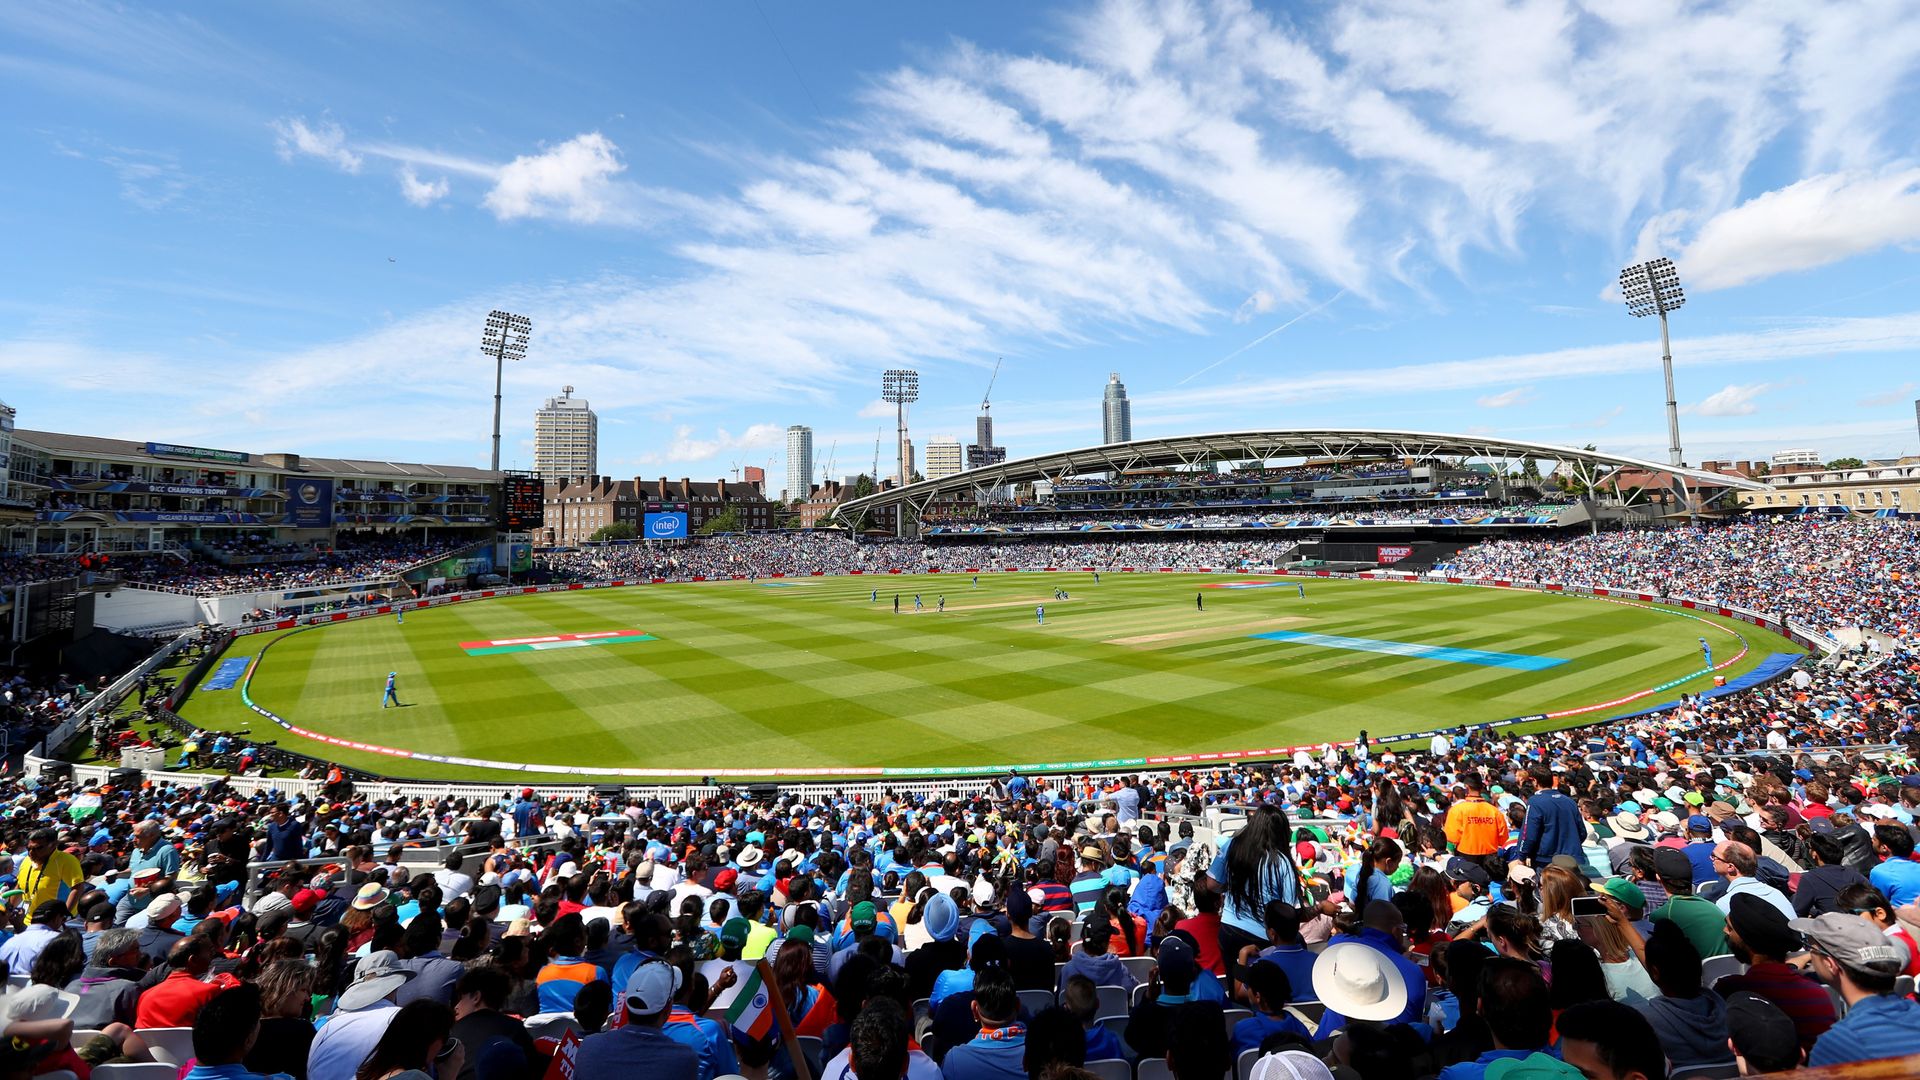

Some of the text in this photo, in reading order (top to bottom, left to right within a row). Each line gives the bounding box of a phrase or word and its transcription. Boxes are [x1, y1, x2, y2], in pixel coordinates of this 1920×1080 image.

[154, 444, 242, 459] WHERE HEROES BECOME CHAMPIONS
[168, 486, 203, 494] CHAMPIONS
[656, 520, 674, 530] intel
[1380, 547, 1410, 556] MRF
[1468, 816, 1494, 825] STEWARD
